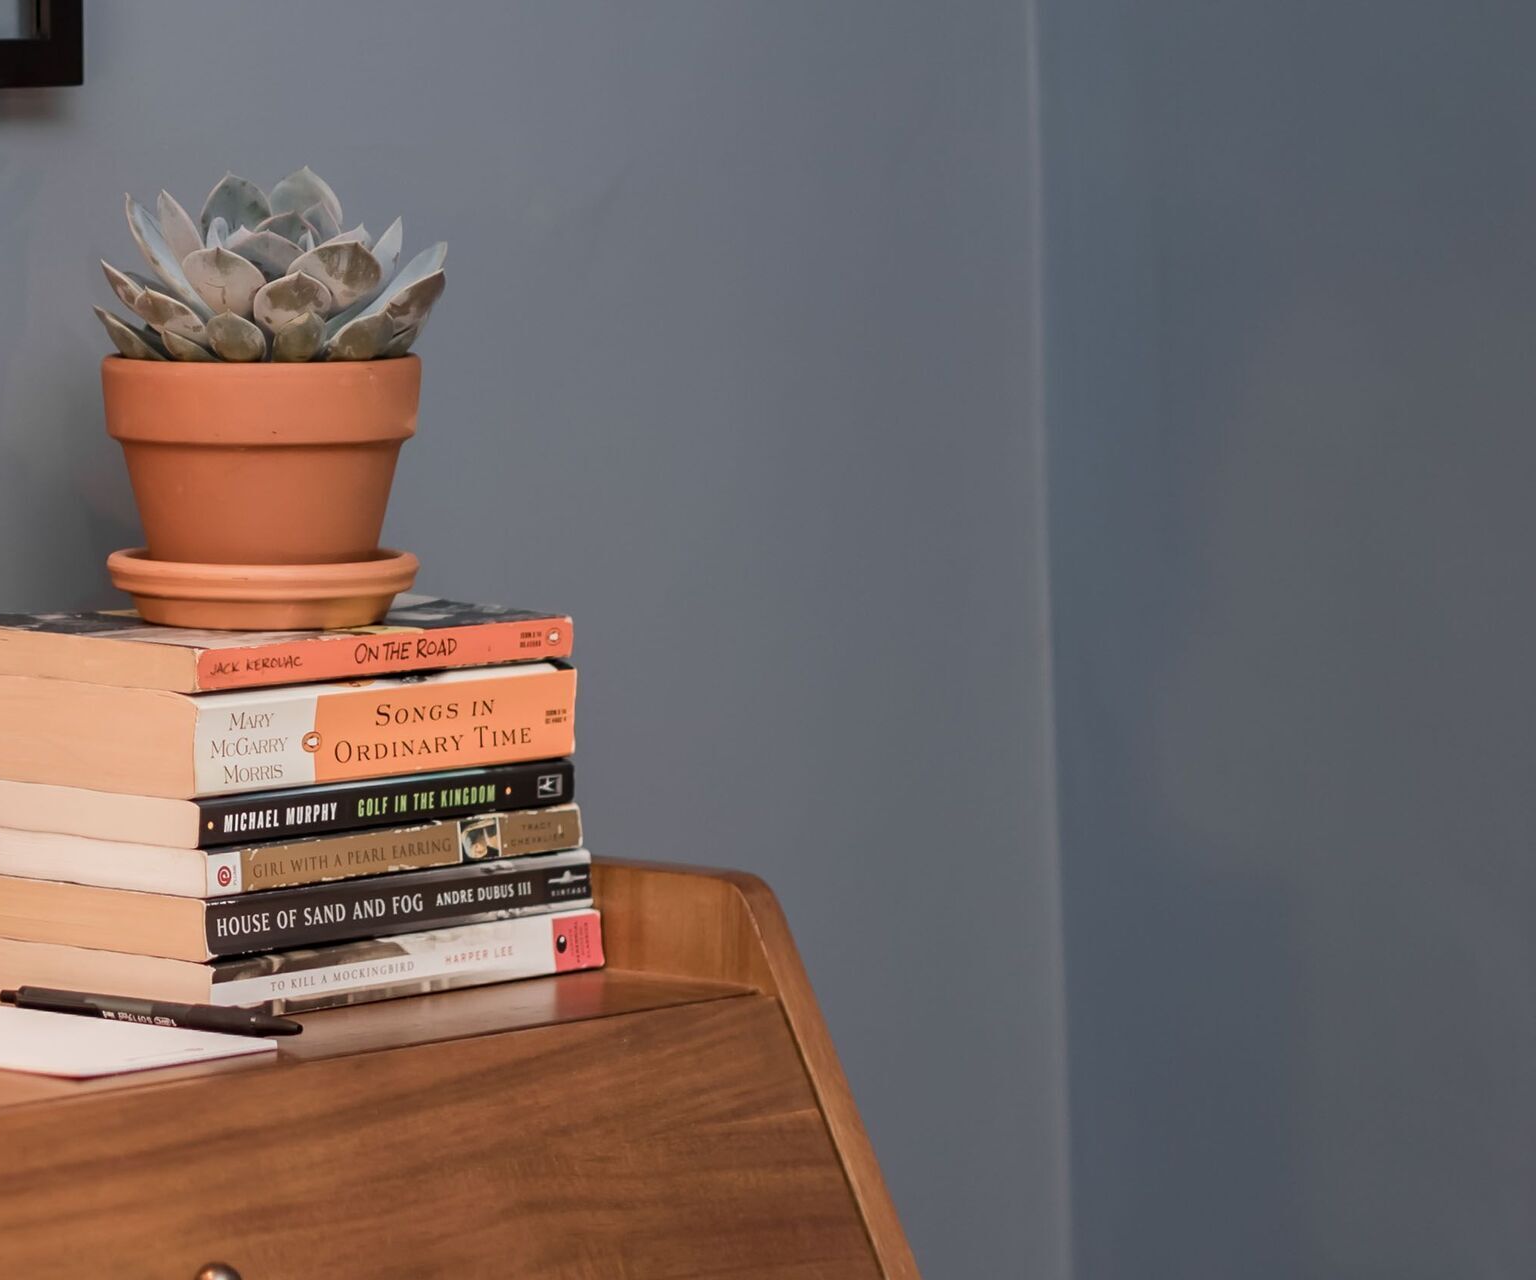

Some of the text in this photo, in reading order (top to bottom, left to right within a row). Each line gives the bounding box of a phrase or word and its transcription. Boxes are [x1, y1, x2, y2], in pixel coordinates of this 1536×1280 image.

[210, 654, 304, 677] JACK KEROUAC
[354, 635, 458, 665] ON THE ROAD
[228, 710, 275, 732] MARY
[375, 698, 495, 728] SONGS IN
[334, 725, 532, 765] ORDINARY TIME
[223, 762, 284, 785] MORRIS
[223, 783, 497, 834] MICHAEL MURPHY GOLF IN THE KINGDOM
[252, 860, 286, 880] GIRL
[290, 855, 329, 876] WITH
[333, 853, 344, 868] A
[347, 845, 389, 867] PEARL
[392, 837, 453, 862] EARRING
[216, 881, 532, 938] HOUSE OF SAND AND FOG ANDRE DUBUS III
[270, 945, 515, 992] TO KILL A MOCKINGBIRD HARPER LEE
